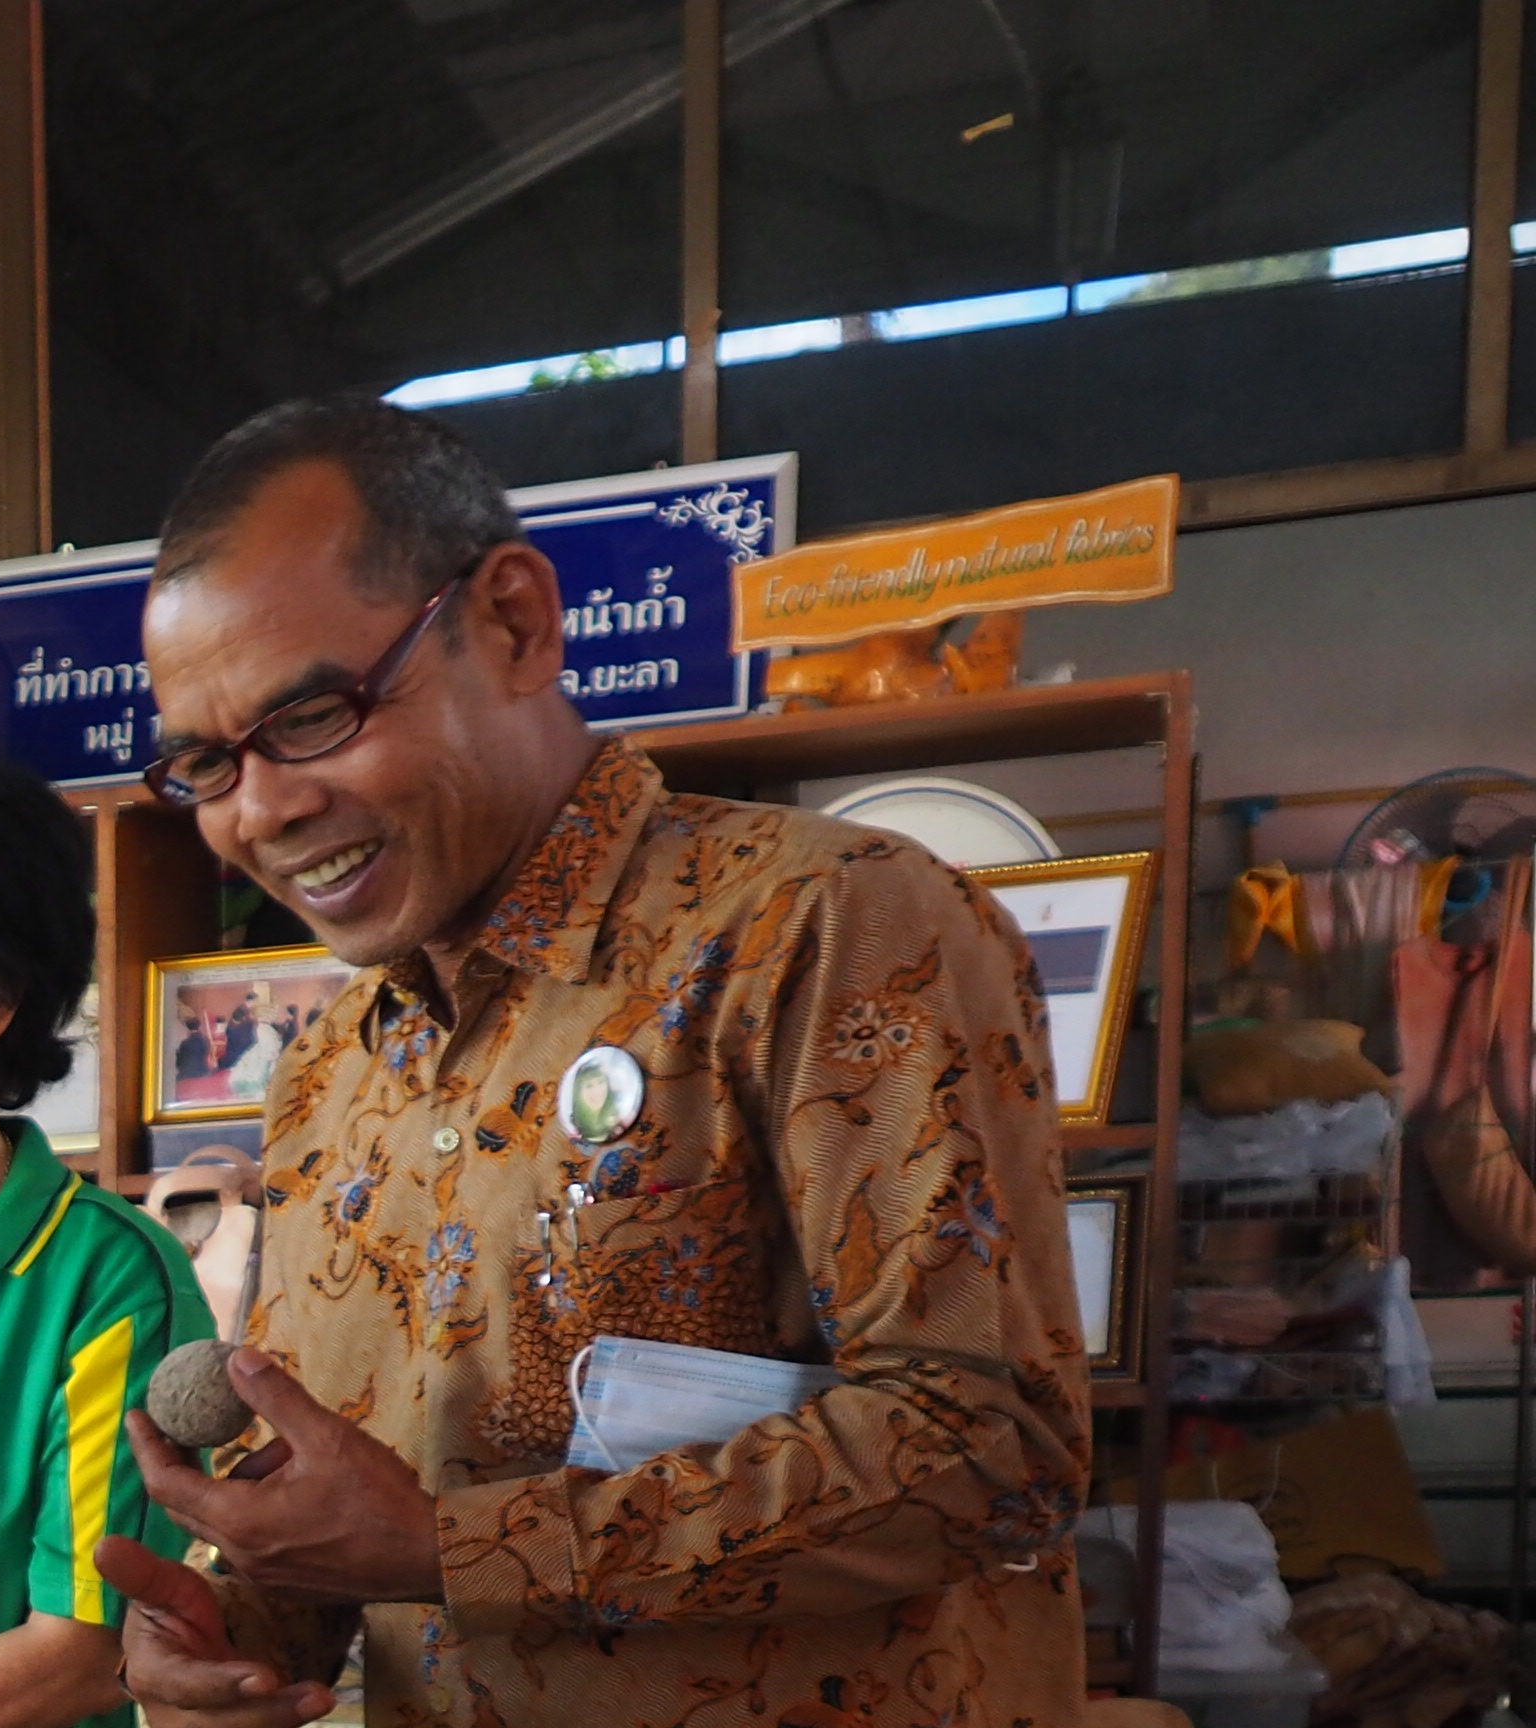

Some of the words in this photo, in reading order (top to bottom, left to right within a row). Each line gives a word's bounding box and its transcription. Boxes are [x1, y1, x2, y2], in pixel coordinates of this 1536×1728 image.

[763, 547, 940, 620] Eco-friendly
[941, 528, 1056, 587] natural
[1063, 517, 1156, 565] fabrics
[85, 706, 134, 761] หมู่
